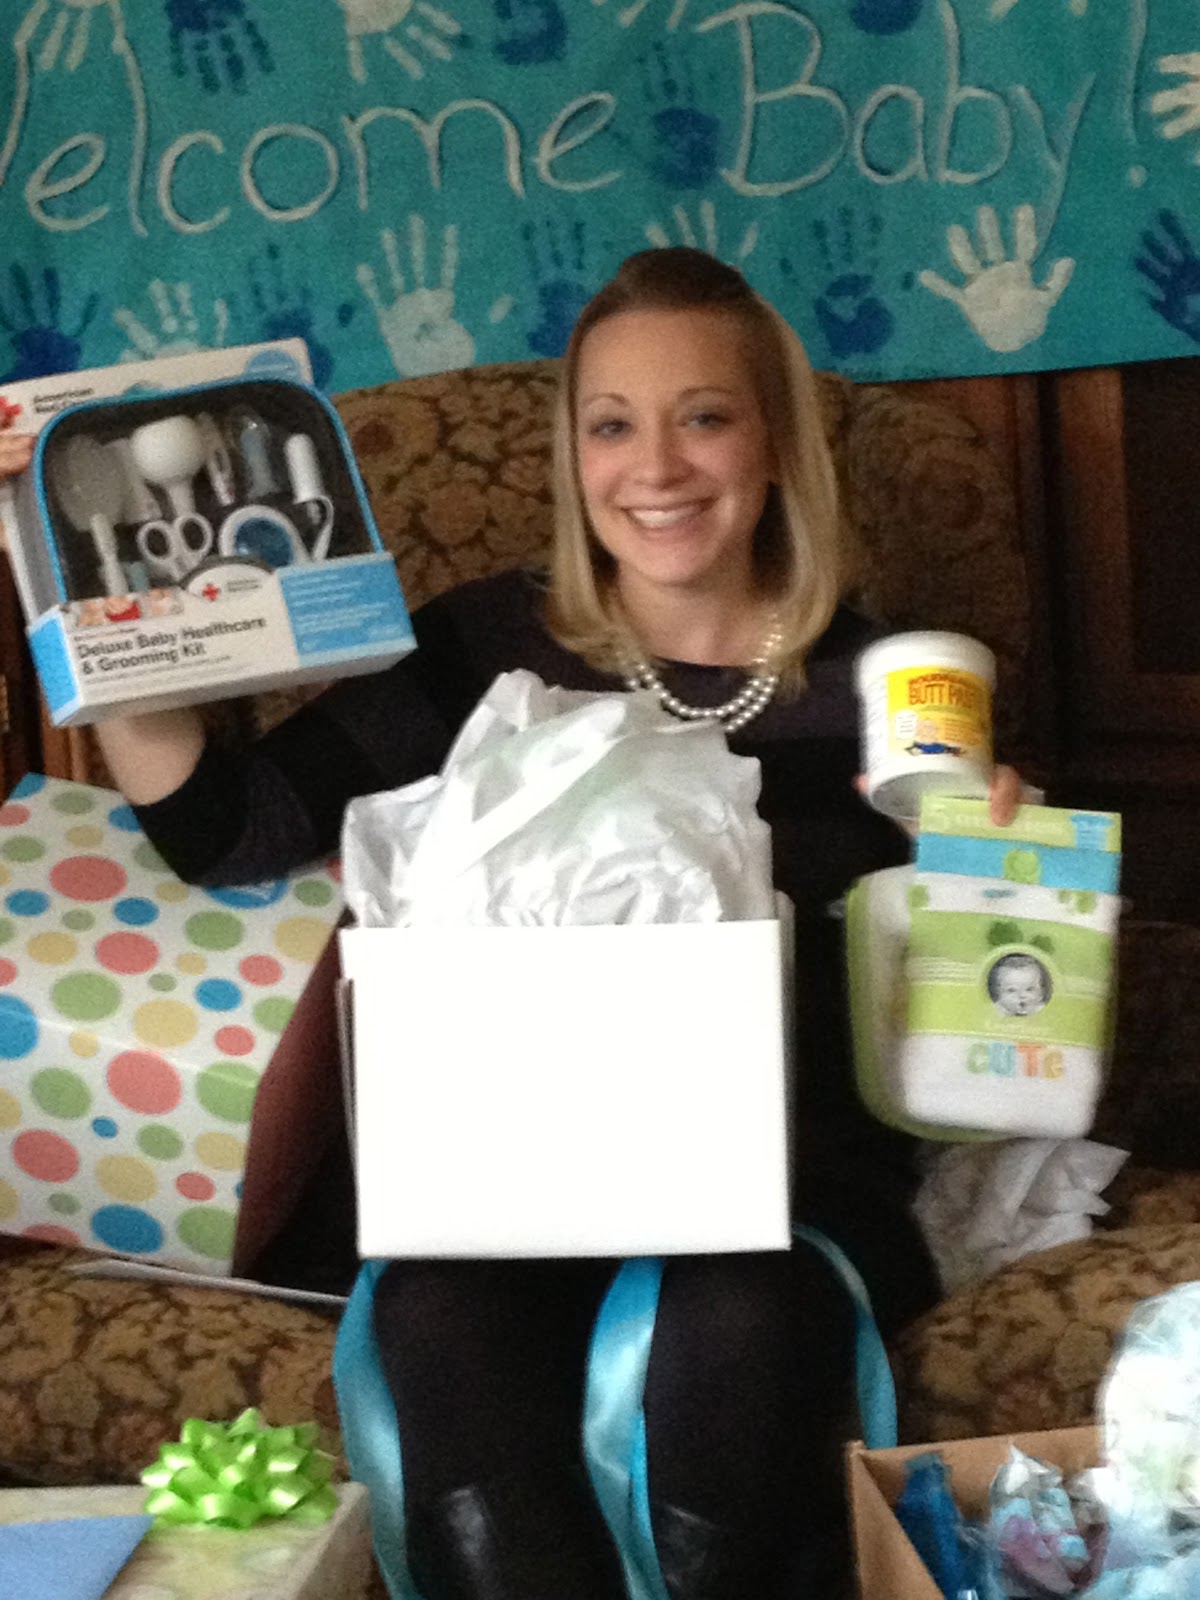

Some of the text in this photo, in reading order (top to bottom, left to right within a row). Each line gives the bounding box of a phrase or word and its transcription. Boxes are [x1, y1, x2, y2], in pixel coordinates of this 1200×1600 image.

[0, 0, 1148, 266] elcome Baby!
[78, 638, 133, 659] Deluxe
[137, 632, 178, 649] Baby
[181, 617, 266, 640] Healthcare
[81, 642, 206, 675] & Grooming Kit
